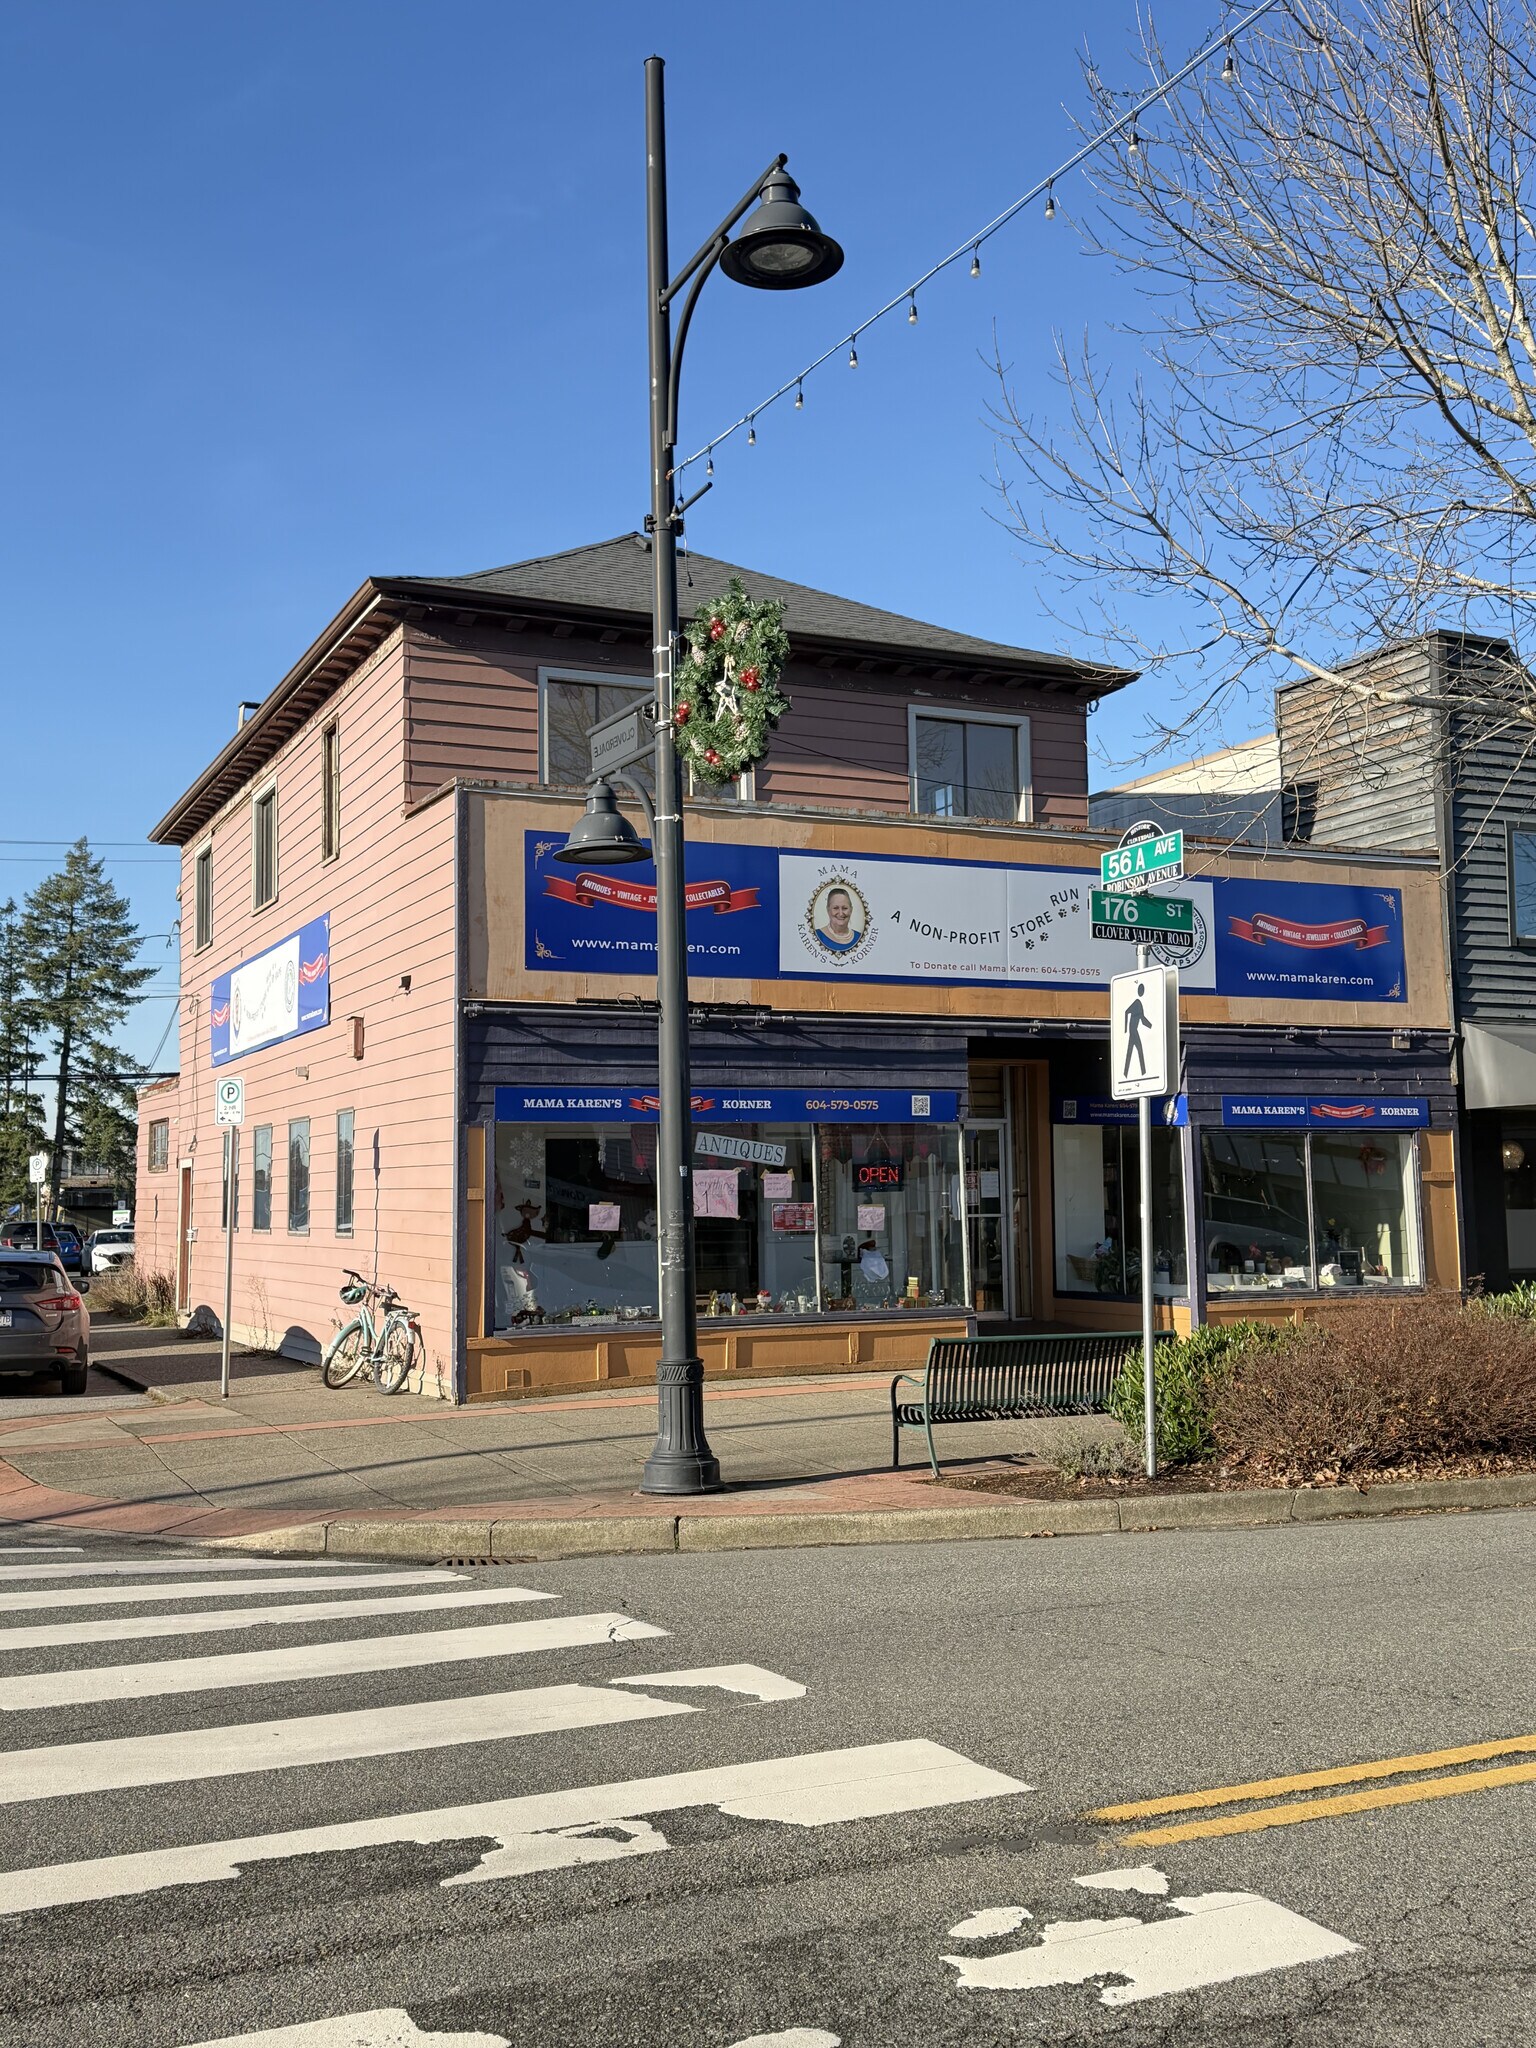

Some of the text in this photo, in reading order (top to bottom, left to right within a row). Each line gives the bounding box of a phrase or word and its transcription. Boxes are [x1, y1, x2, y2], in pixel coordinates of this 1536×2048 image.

[1108, 837, 1176, 878] 56 A AVE
[817, 864, 858, 879] MAMA
[1106, 865, 1178, 892] ROBINSON AVENUE
[582, 879, 612, 896] ANTIQUES
[616, 889, 642, 902] VINTAGE
[890, 910, 901, 923] A
[909, 918, 1001, 945] NON-PROFIT
[1010, 910, 1053, 939] STORE
[1049, 887, 1080, 907] RUN
[1100, 897, 1139, 923] 176
[1166, 903, 1184, 918] ST
[1095, 925, 1191, 946] CLOVER VALLEY ROAD
[1256, 919, 1363, 941] ANTIQUES VINTAGE JEWELLERY COLLECTABLES
[571, 938, 741, 955] www.mamaen.com
[797, 923, 828, 964] KAREN'S
[850, 927, 879, 965] KORNER
[910, 961, 1101, 976] To Donate call Mama Karen: 604-579-0575
[1164, 956, 1191, 967] RAPS
[1246, 972, 1374, 986] www.mamakaren.com
[227, 1086, 235, 1099] P
[523, 1098, 772, 1110] MAMA KAREN'S KORNER
[805, 1099, 880, 1111] 604-579-0575
[1231, 1105, 1420, 1116] MAMA KAREN'S KORNER
[699, 1135, 784, 1165] ANTIQUES
[858, 1166, 899, 1184] OPEN
